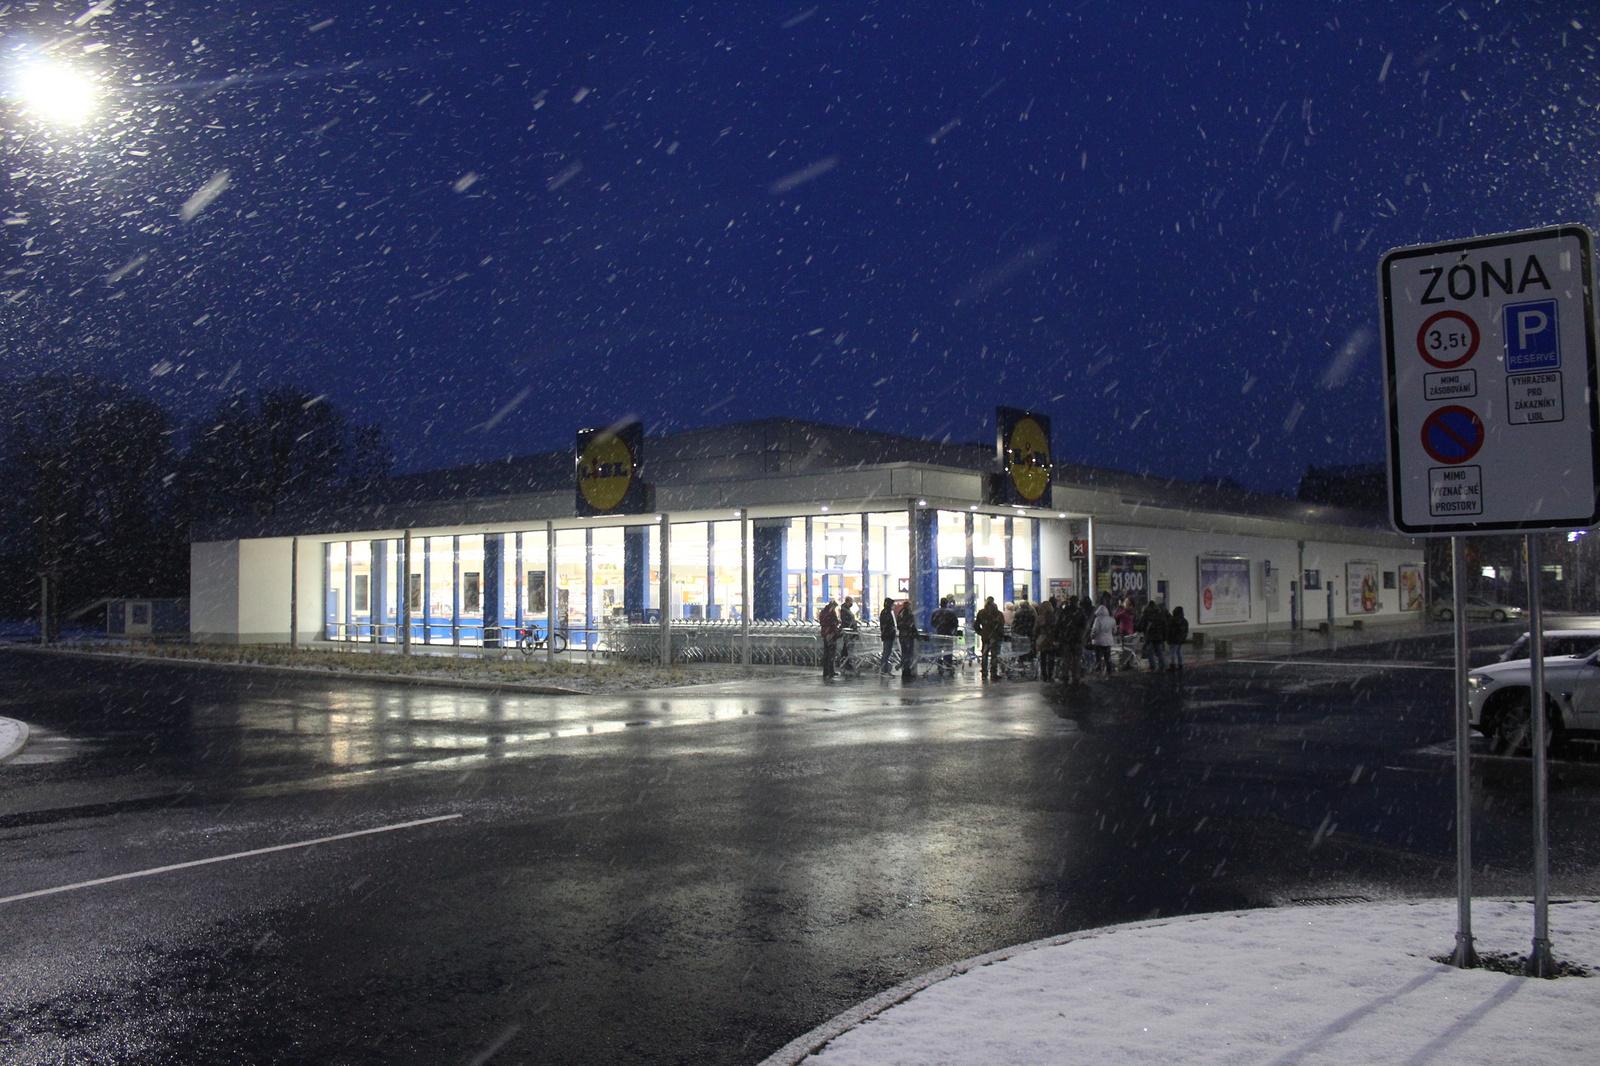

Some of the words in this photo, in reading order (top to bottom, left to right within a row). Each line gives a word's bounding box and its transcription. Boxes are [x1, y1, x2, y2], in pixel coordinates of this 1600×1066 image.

[1418, 253, 1552, 304] ZÓNA
[1517, 309, 1548, 350] P
[1440, 375, 1460, 385] MIMO
[1511, 374, 1557, 386] VYHRAZENO
[1527, 388, 1543, 397] PRO
[1514, 397, 1556, 410] ZÁKAZNÍKY
[1443, 470, 1466, 481] MIMO
[1435, 501, 1477, 513] PROSTORY
